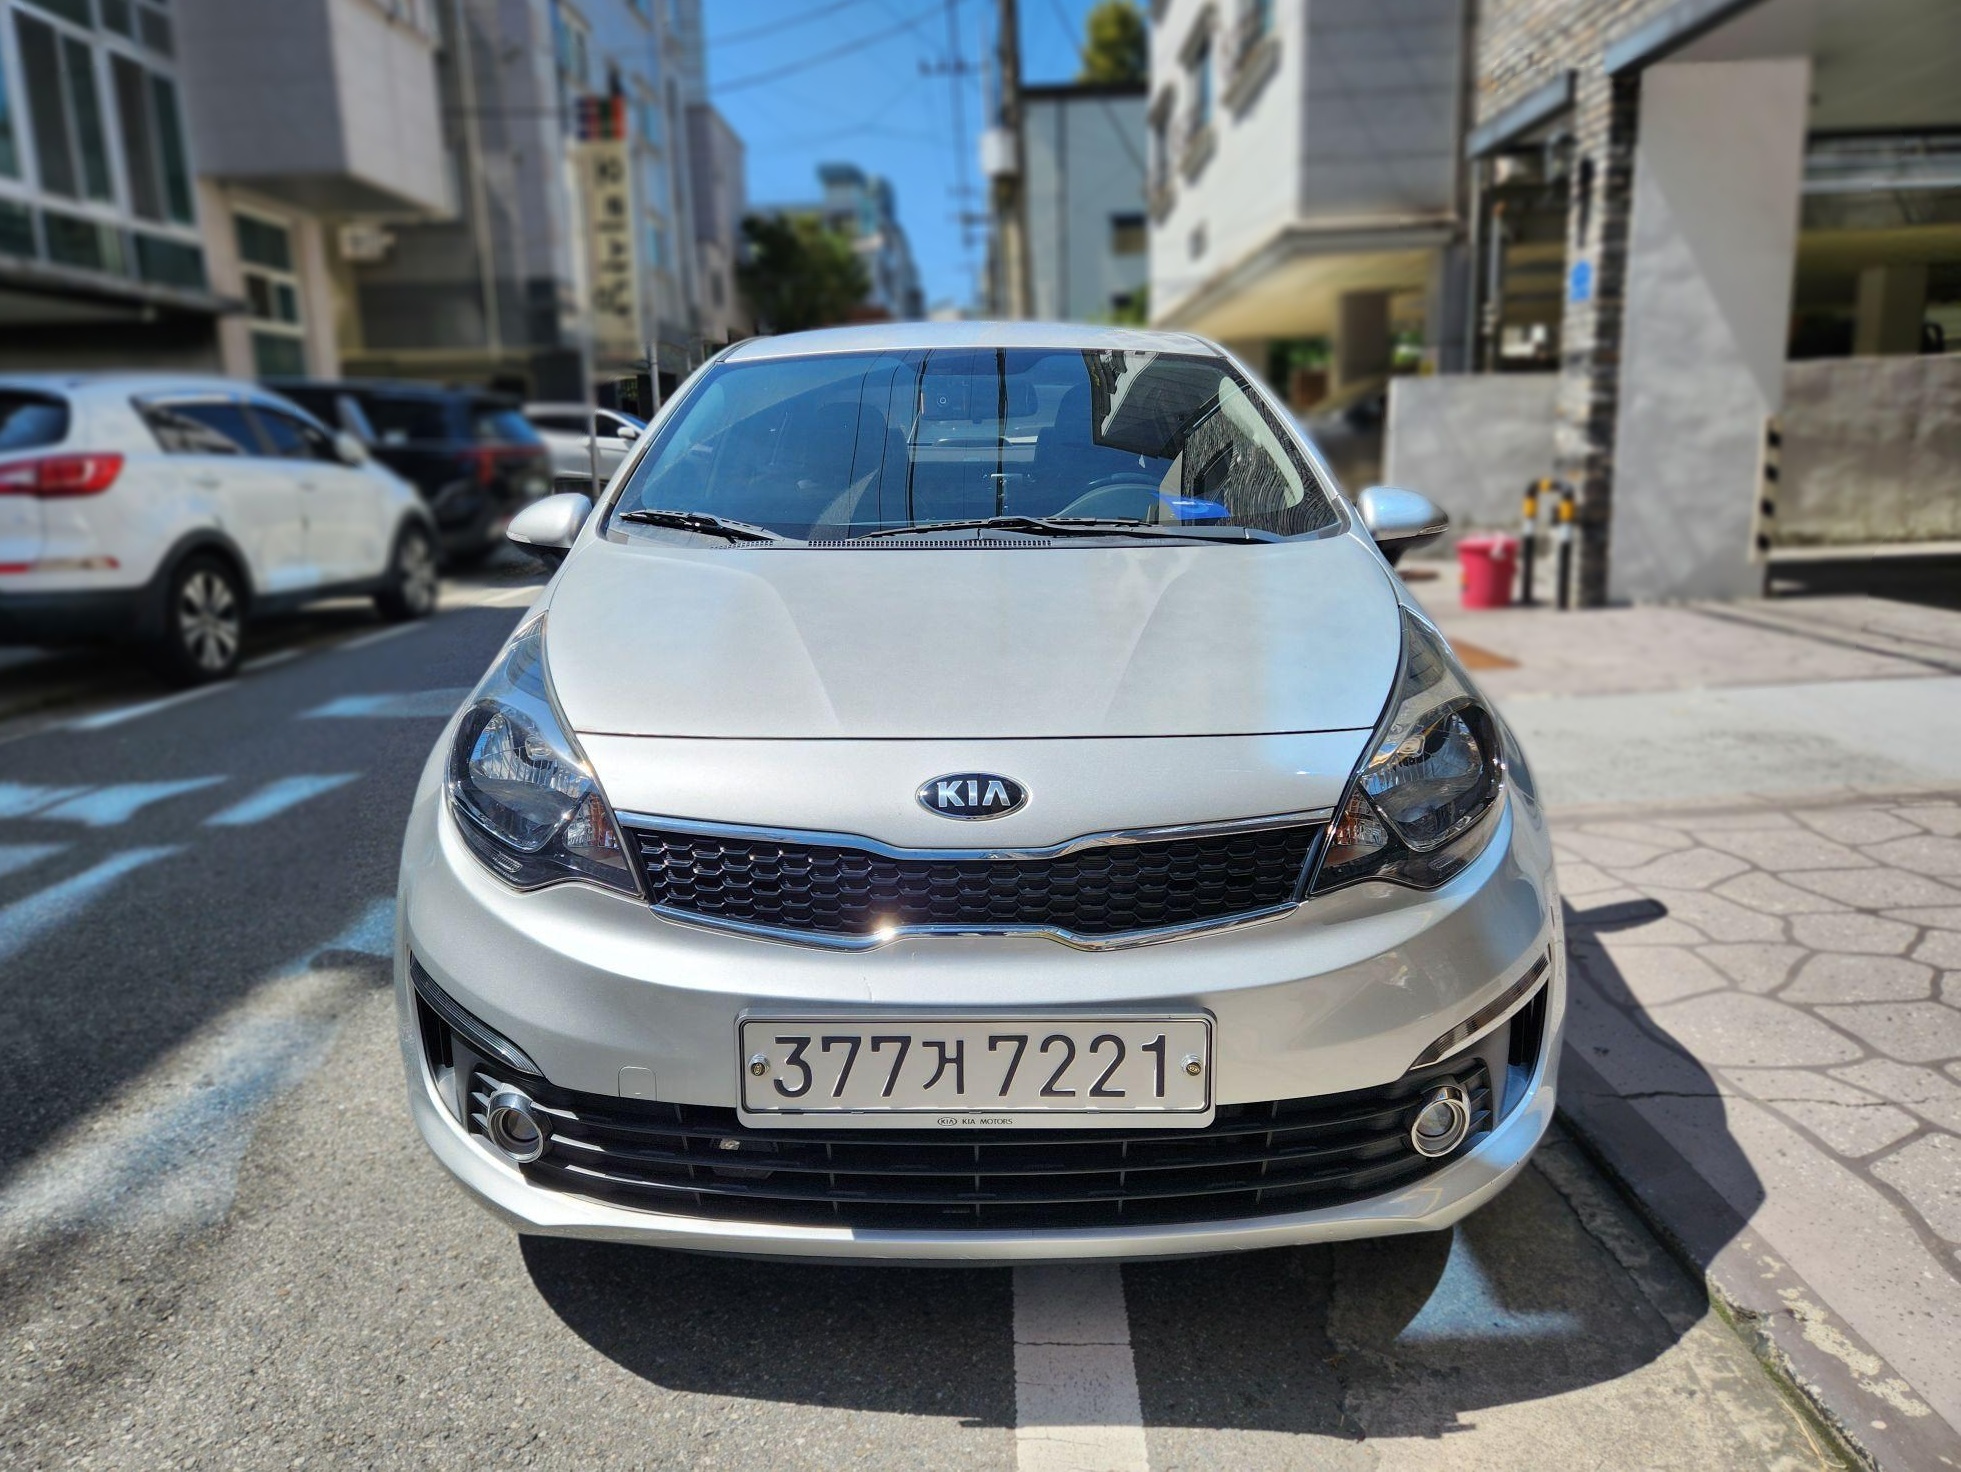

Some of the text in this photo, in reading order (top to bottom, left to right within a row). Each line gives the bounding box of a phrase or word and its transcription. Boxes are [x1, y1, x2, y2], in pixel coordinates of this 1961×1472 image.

[936, 780, 1011, 808] KIA
[773, 1034, 1166, 1098] 377거 7221
